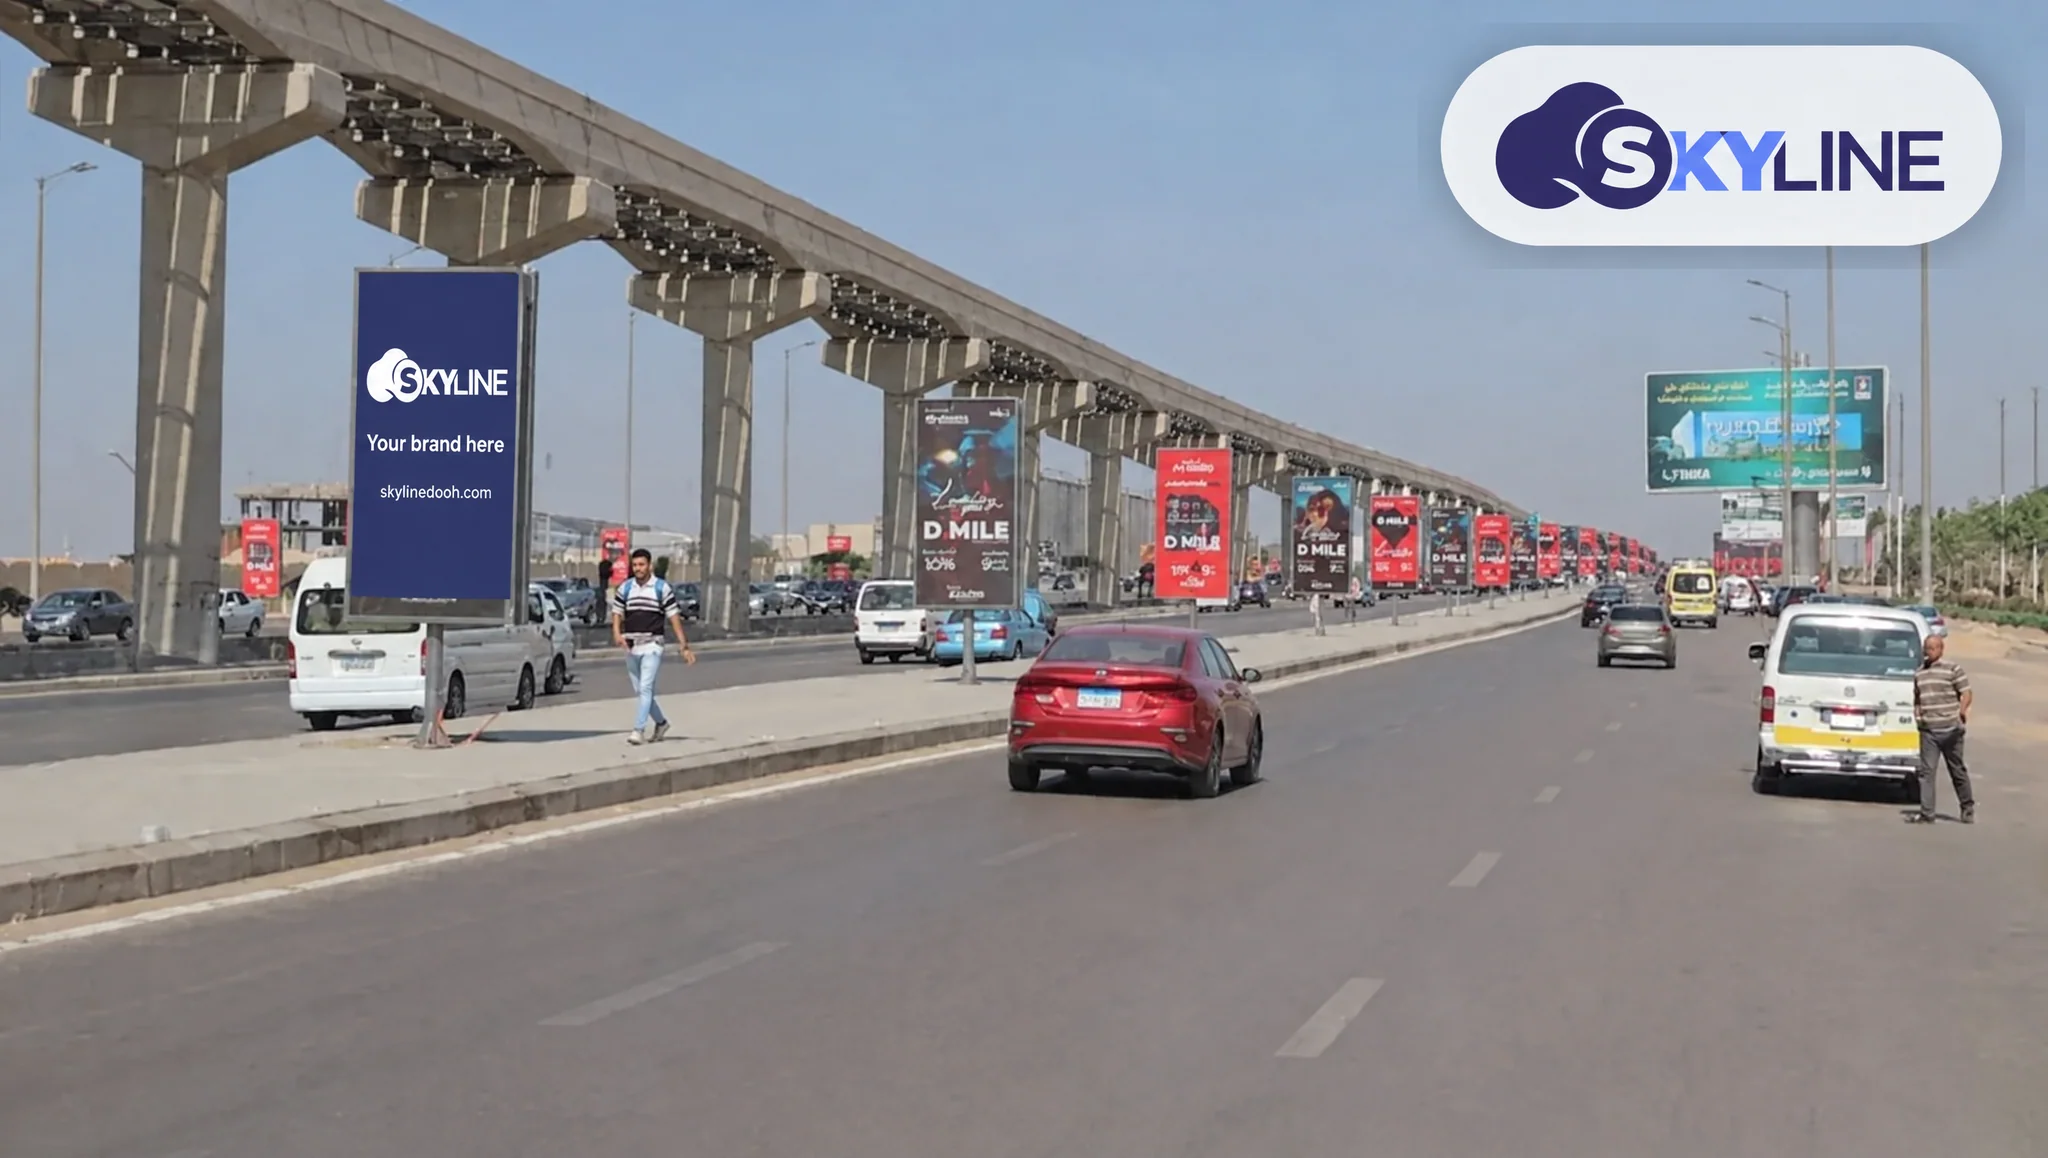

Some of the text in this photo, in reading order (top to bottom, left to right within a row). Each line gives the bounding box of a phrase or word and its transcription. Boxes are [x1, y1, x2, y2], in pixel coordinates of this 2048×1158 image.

[400, 367, 508, 396] SKYLINE
[366, 434, 504, 453] Your brand here
[380, 484, 492, 501] skylinedooh.com
[923, 520, 1009, 540] D MILE
[1164, 535, 1177, 548] D
[1297, 543, 1346, 556] D MILE
